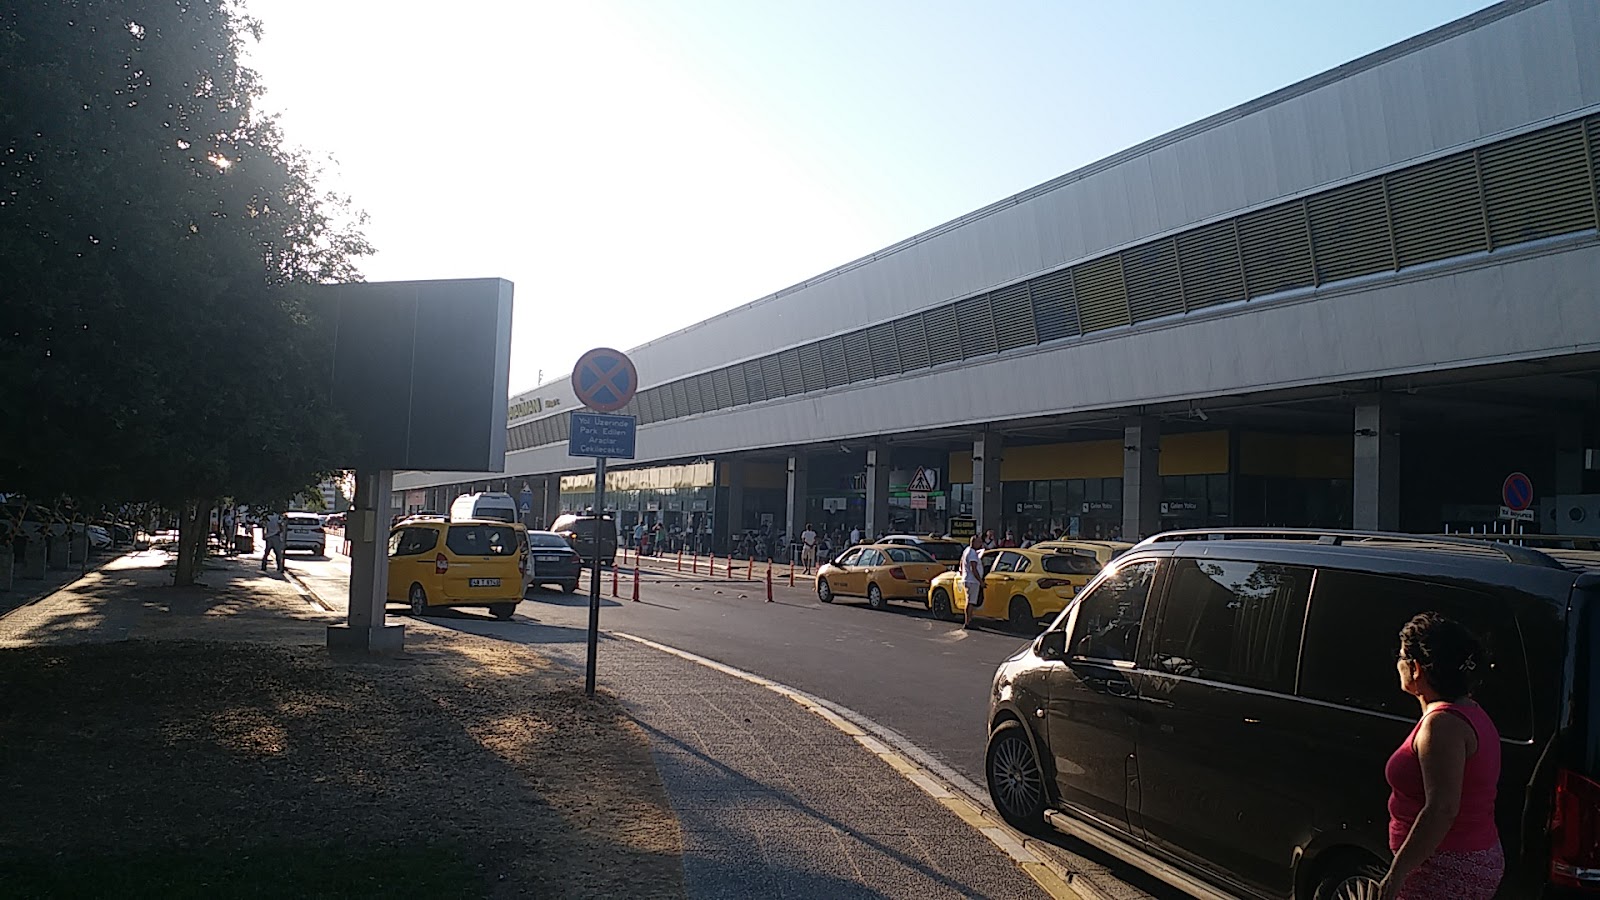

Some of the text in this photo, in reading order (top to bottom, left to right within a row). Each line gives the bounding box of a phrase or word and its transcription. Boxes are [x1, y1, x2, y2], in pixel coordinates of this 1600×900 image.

[578, 416, 629, 427] Yol Üzerinde
[580, 426, 626, 436] Park Edilen
